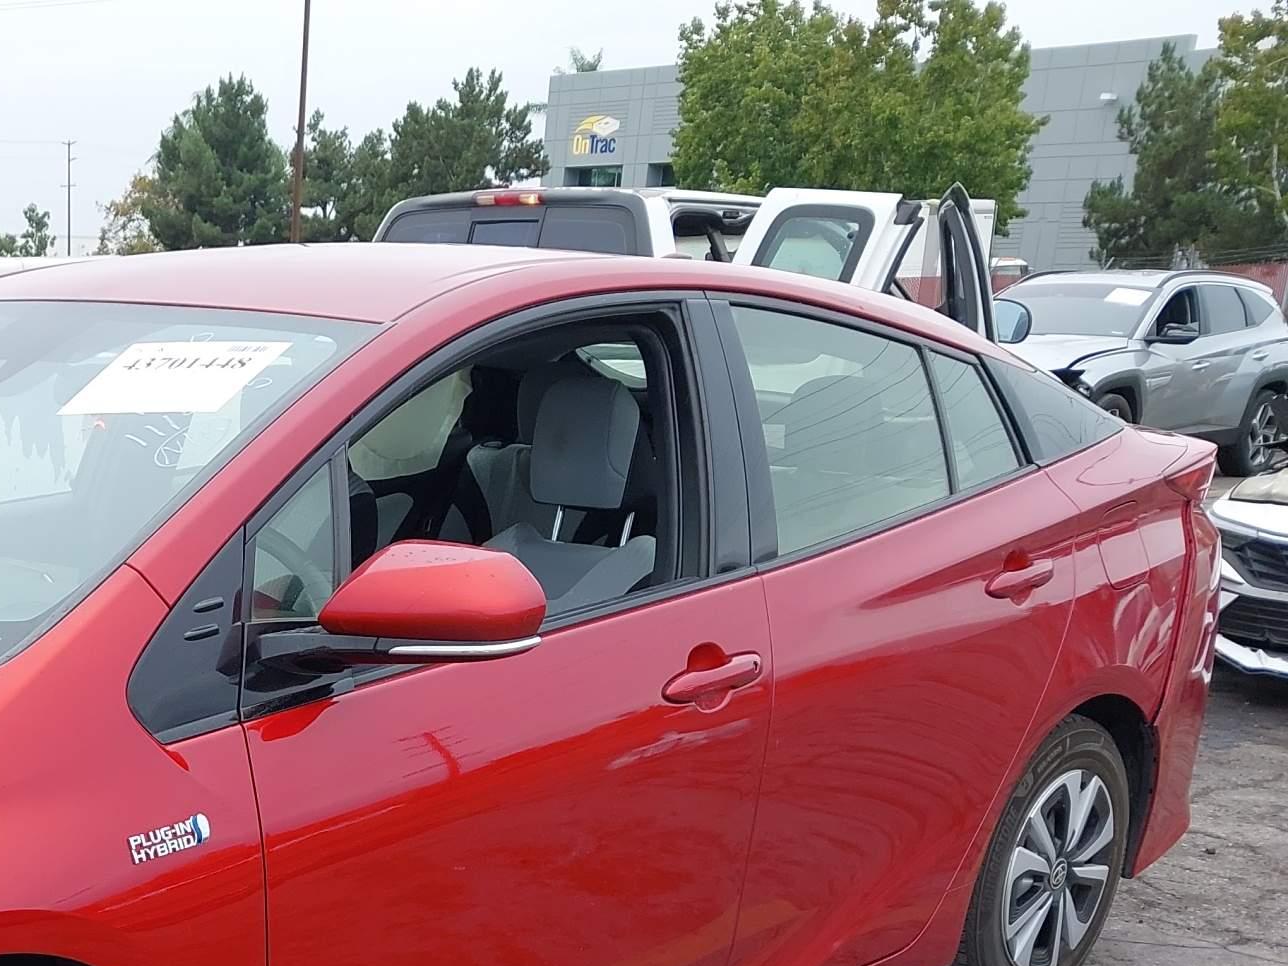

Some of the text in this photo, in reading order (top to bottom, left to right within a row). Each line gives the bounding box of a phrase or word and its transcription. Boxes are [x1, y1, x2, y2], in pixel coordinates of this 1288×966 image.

[572, 134, 617, 155] OnTrac
[122, 356, 253, 371] 43701448
[128, 818, 193, 850] PLUG-IN
[132, 834, 197, 865] HYBRID
